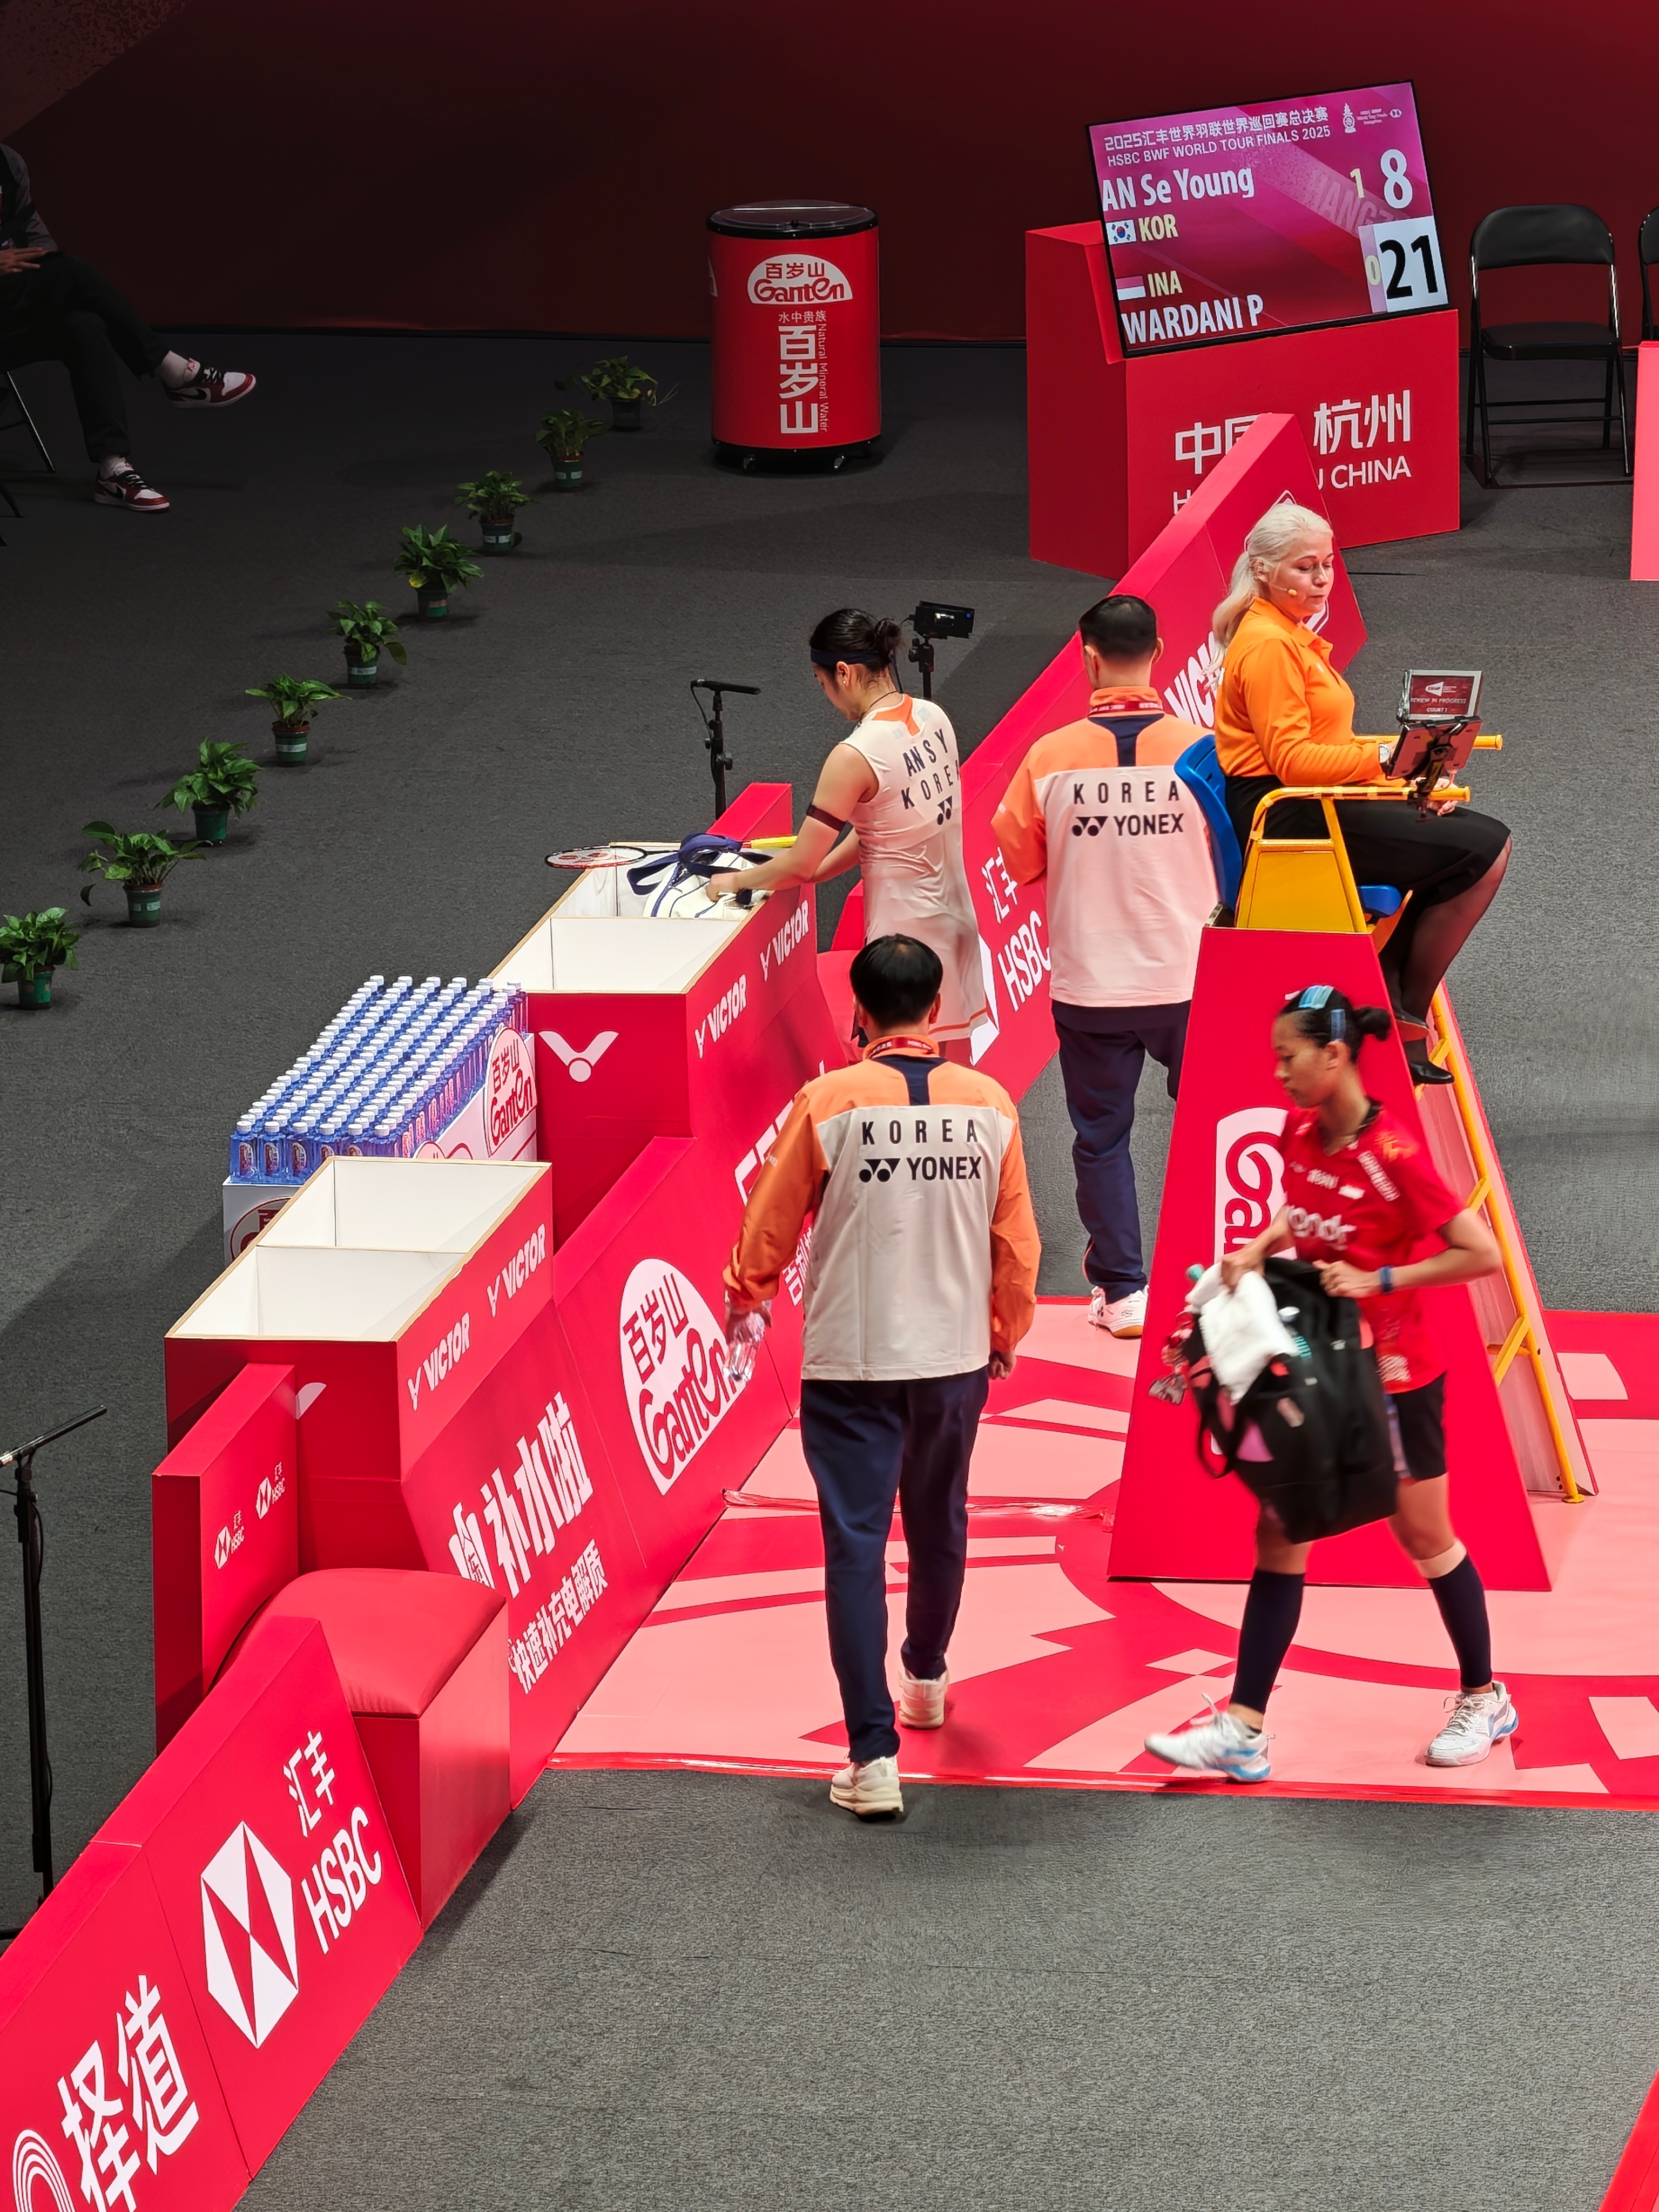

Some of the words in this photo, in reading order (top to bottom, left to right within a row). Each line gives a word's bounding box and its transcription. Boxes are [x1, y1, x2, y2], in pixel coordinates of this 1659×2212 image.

[1104, 106, 1328, 151] 2025汇丰世界羽联世界巡回赛总决赛
[1107, 152, 1140, 167] HSBC
[1144, 147, 1170, 162] BWF
[1174, 141, 1217, 158] WORLD
[1220, 135, 1255, 151] TOUR
[1257, 130, 1299, 146] FINALS
[1303, 125, 1331, 140] 2025
[1102, 176, 1136, 212] AN
[1141, 173, 1172, 207] Se
[1173, 167, 1255, 201] Young
[1350, 168, 1365, 199] 1
[1380, 149, 1413, 209] 8
[1139, 214, 1178, 242] KOR
[765, 262, 825, 279] 百岁山
[1147, 271, 1183, 298] INA
[1379, 234, 1439, 300] 21
[754, 278, 845, 302] Ganten
[778, 309, 827, 323] 水中贵族
[1121, 296, 1243, 344] WARDANI
[1246, 294, 1264, 327] P
[818, 324, 828, 360] Natural
[778, 325, 819, 434] 百岁山
[819, 363, 828, 399] Mineral
[820, 402, 829, 432] Water
[1313, 389, 1411, 455] 杭州
[1331, 455, 1412, 489] CHINA
[1074, 780, 1179, 805] KOREA
[1113, 813, 1184, 836] YONEX
[772, 900, 809, 966] VICTOR
[997, 910, 1052, 1013] HSBC
[707, 974, 746, 1043] VICTOR
[492, 1038, 520, 1095] 百岁山
[490, 1068, 534, 1146] Ganten
[862, 1119, 978, 1145] KOREA
[906, 1156, 982, 1181] YONEX
[502, 1223, 547, 1300] VICTOR
[623, 1272, 689, 1386] 百岁山
[423, 1312, 470, 1392] VICTOR
[507, 1538, 609, 1695] 快速补充电解质
[283, 1730, 336, 1838] 汇丰
[301, 1806, 382, 1955] HSBC
